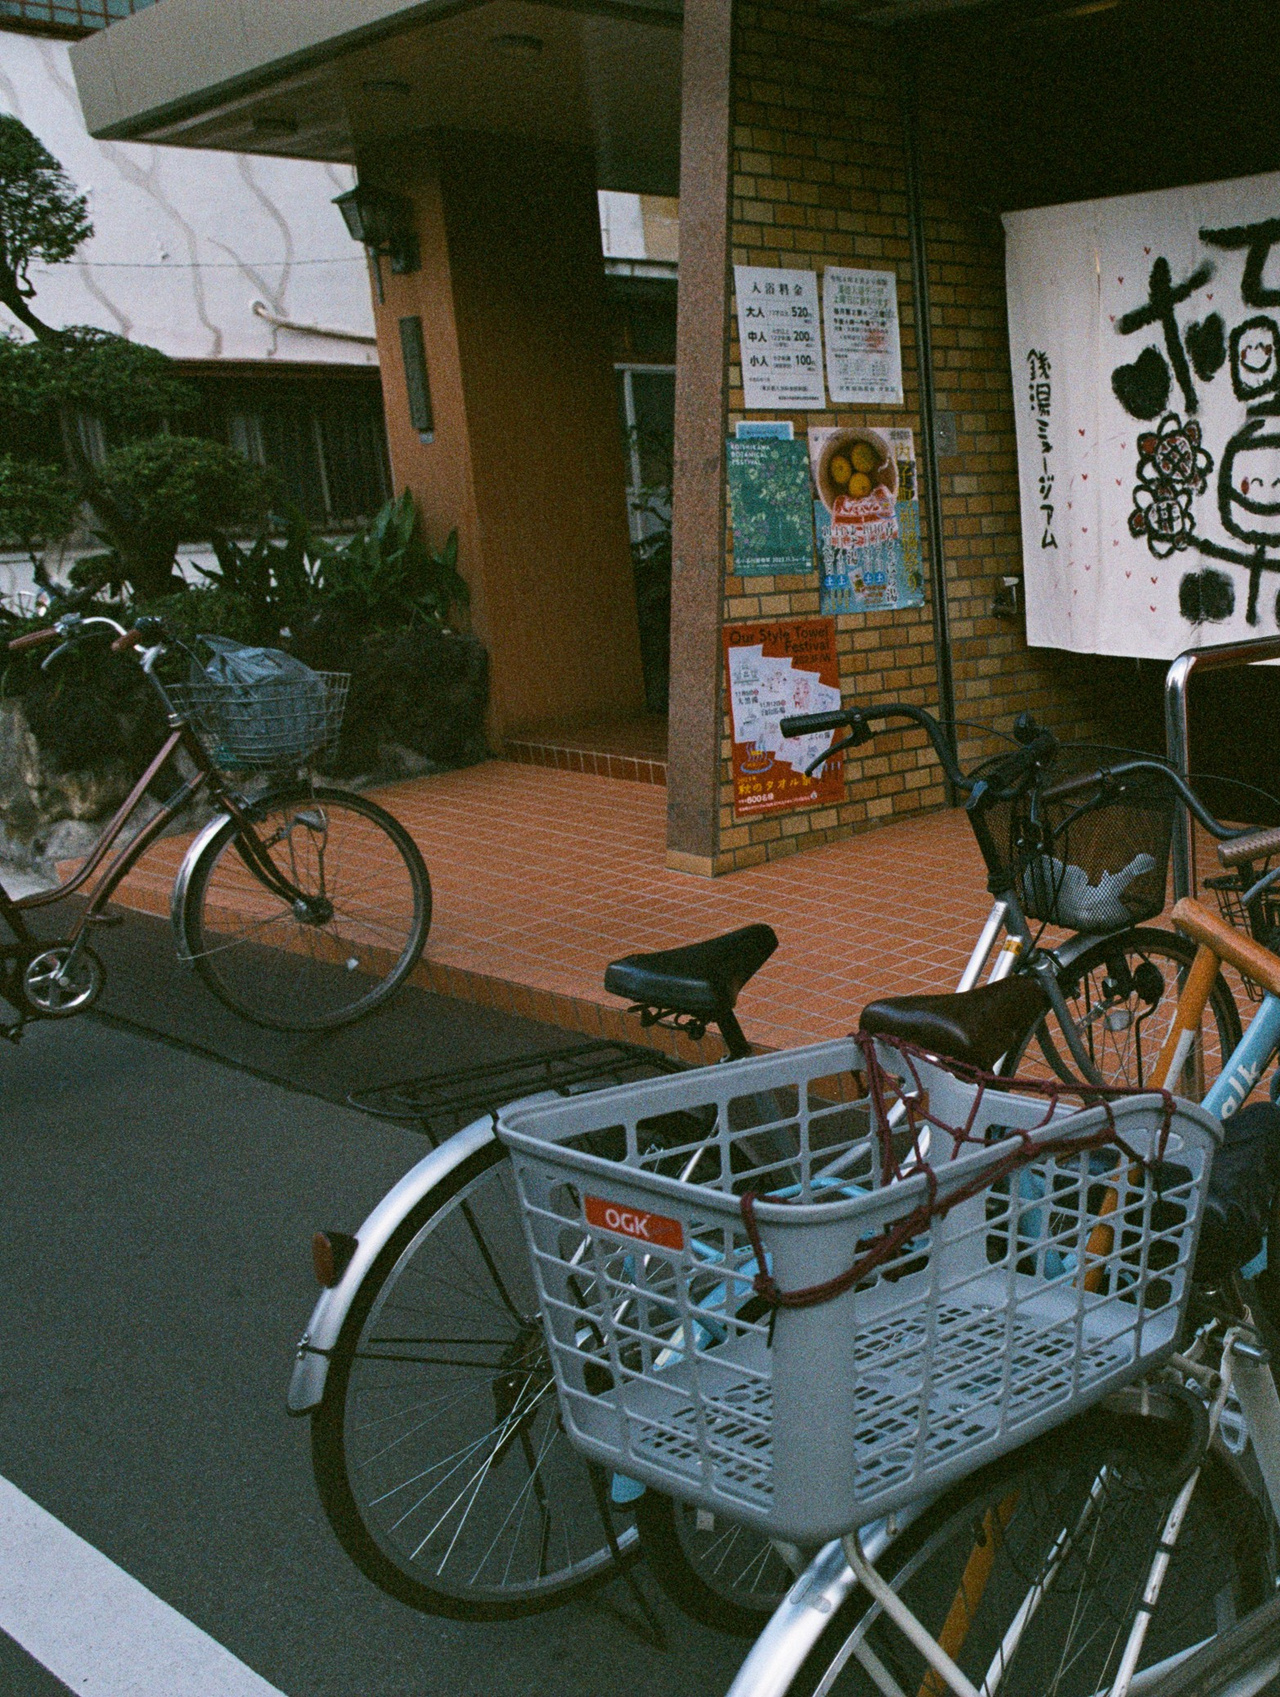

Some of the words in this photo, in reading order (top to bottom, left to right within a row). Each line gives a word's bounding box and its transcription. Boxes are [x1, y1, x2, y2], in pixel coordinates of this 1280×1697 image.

[752, 281, 803, 297] 入浴料金
[746, 307, 765, 319] 大人
[748, 332, 767, 343] 中人
[750, 356, 768, 367] 小人
[730, 630, 754, 644] Our
[759, 627, 790, 645] Style
[793, 624, 829, 639] Towel
[784, 640, 830, 653] Festival
[605, 1209, 650, 1237] OGK
